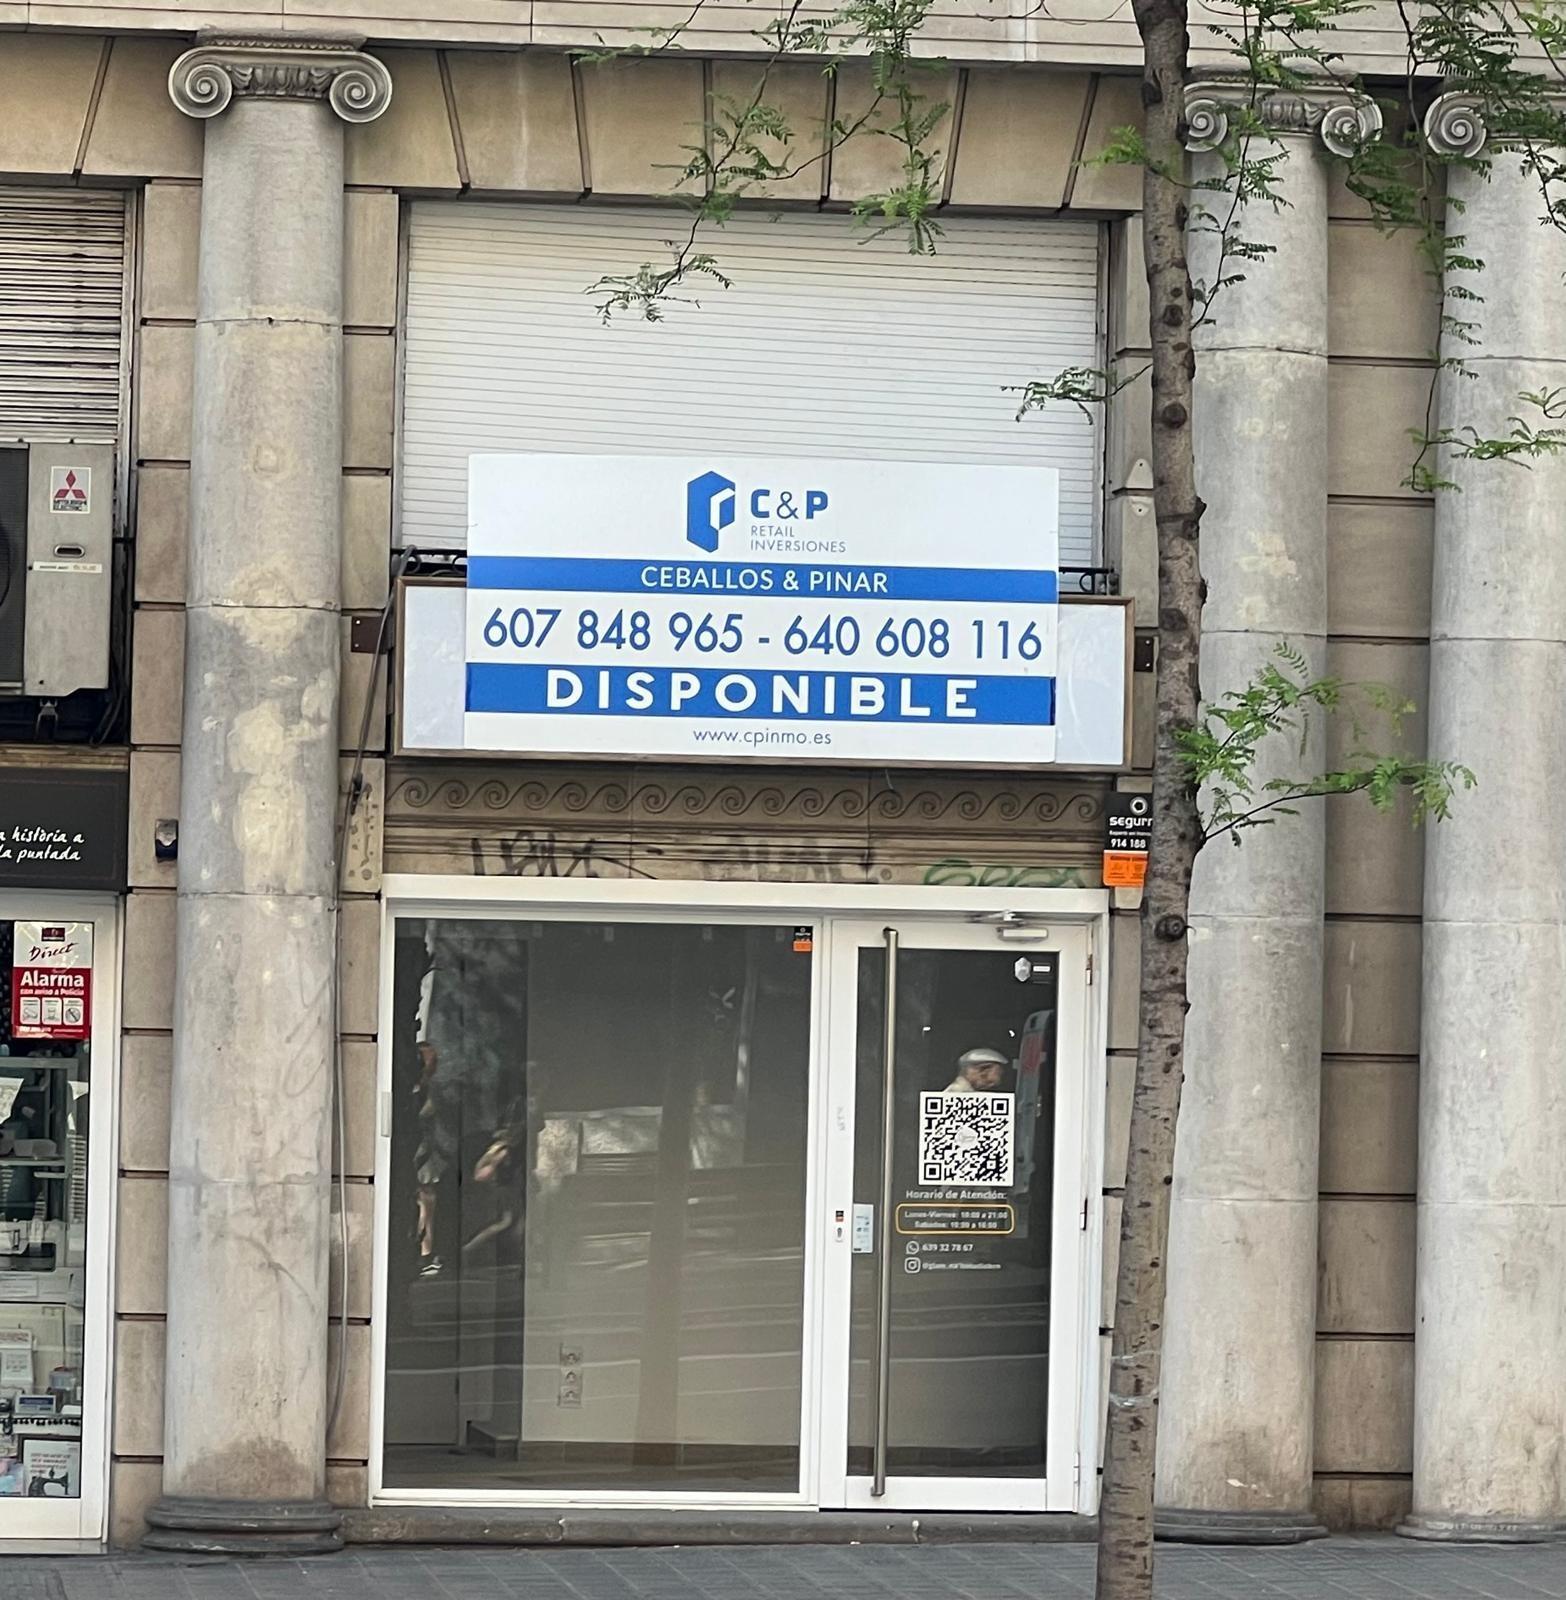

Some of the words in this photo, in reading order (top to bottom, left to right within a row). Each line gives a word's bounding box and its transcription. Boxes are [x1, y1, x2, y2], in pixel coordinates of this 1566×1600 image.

[750, 525, 795, 538] RETAIL
[750, 540, 846, 553] INVERSIONES
[640, 566, 774, 590] CEBALLOS
[782, 571, 799, 591] &
[809, 571, 888, 593] PINAR
[483, 607, 562, 648] 607
[577, 609, 651, 651] 848
[668, 611, 743, 653] 965
[784, 614, 860, 656] 640
[875, 617, 950, 658] 608
[971, 620, 1042, 660] 116
[546, 669, 977, 718] DISPONIBLE
[693, 727, 831, 747] www.cpinmo.es
[73, 833, 85, 843] a
[1111, 838, 1127, 848] 914
[16, 844, 81, 864] puntada
[29, 942, 78, 962] Direct
[21, 970, 85, 988] Alarma
[905, 1189, 943, 1199] Horario
[945, 1190, 958, 1199] de
[939, 1243, 949, 1252] 32
